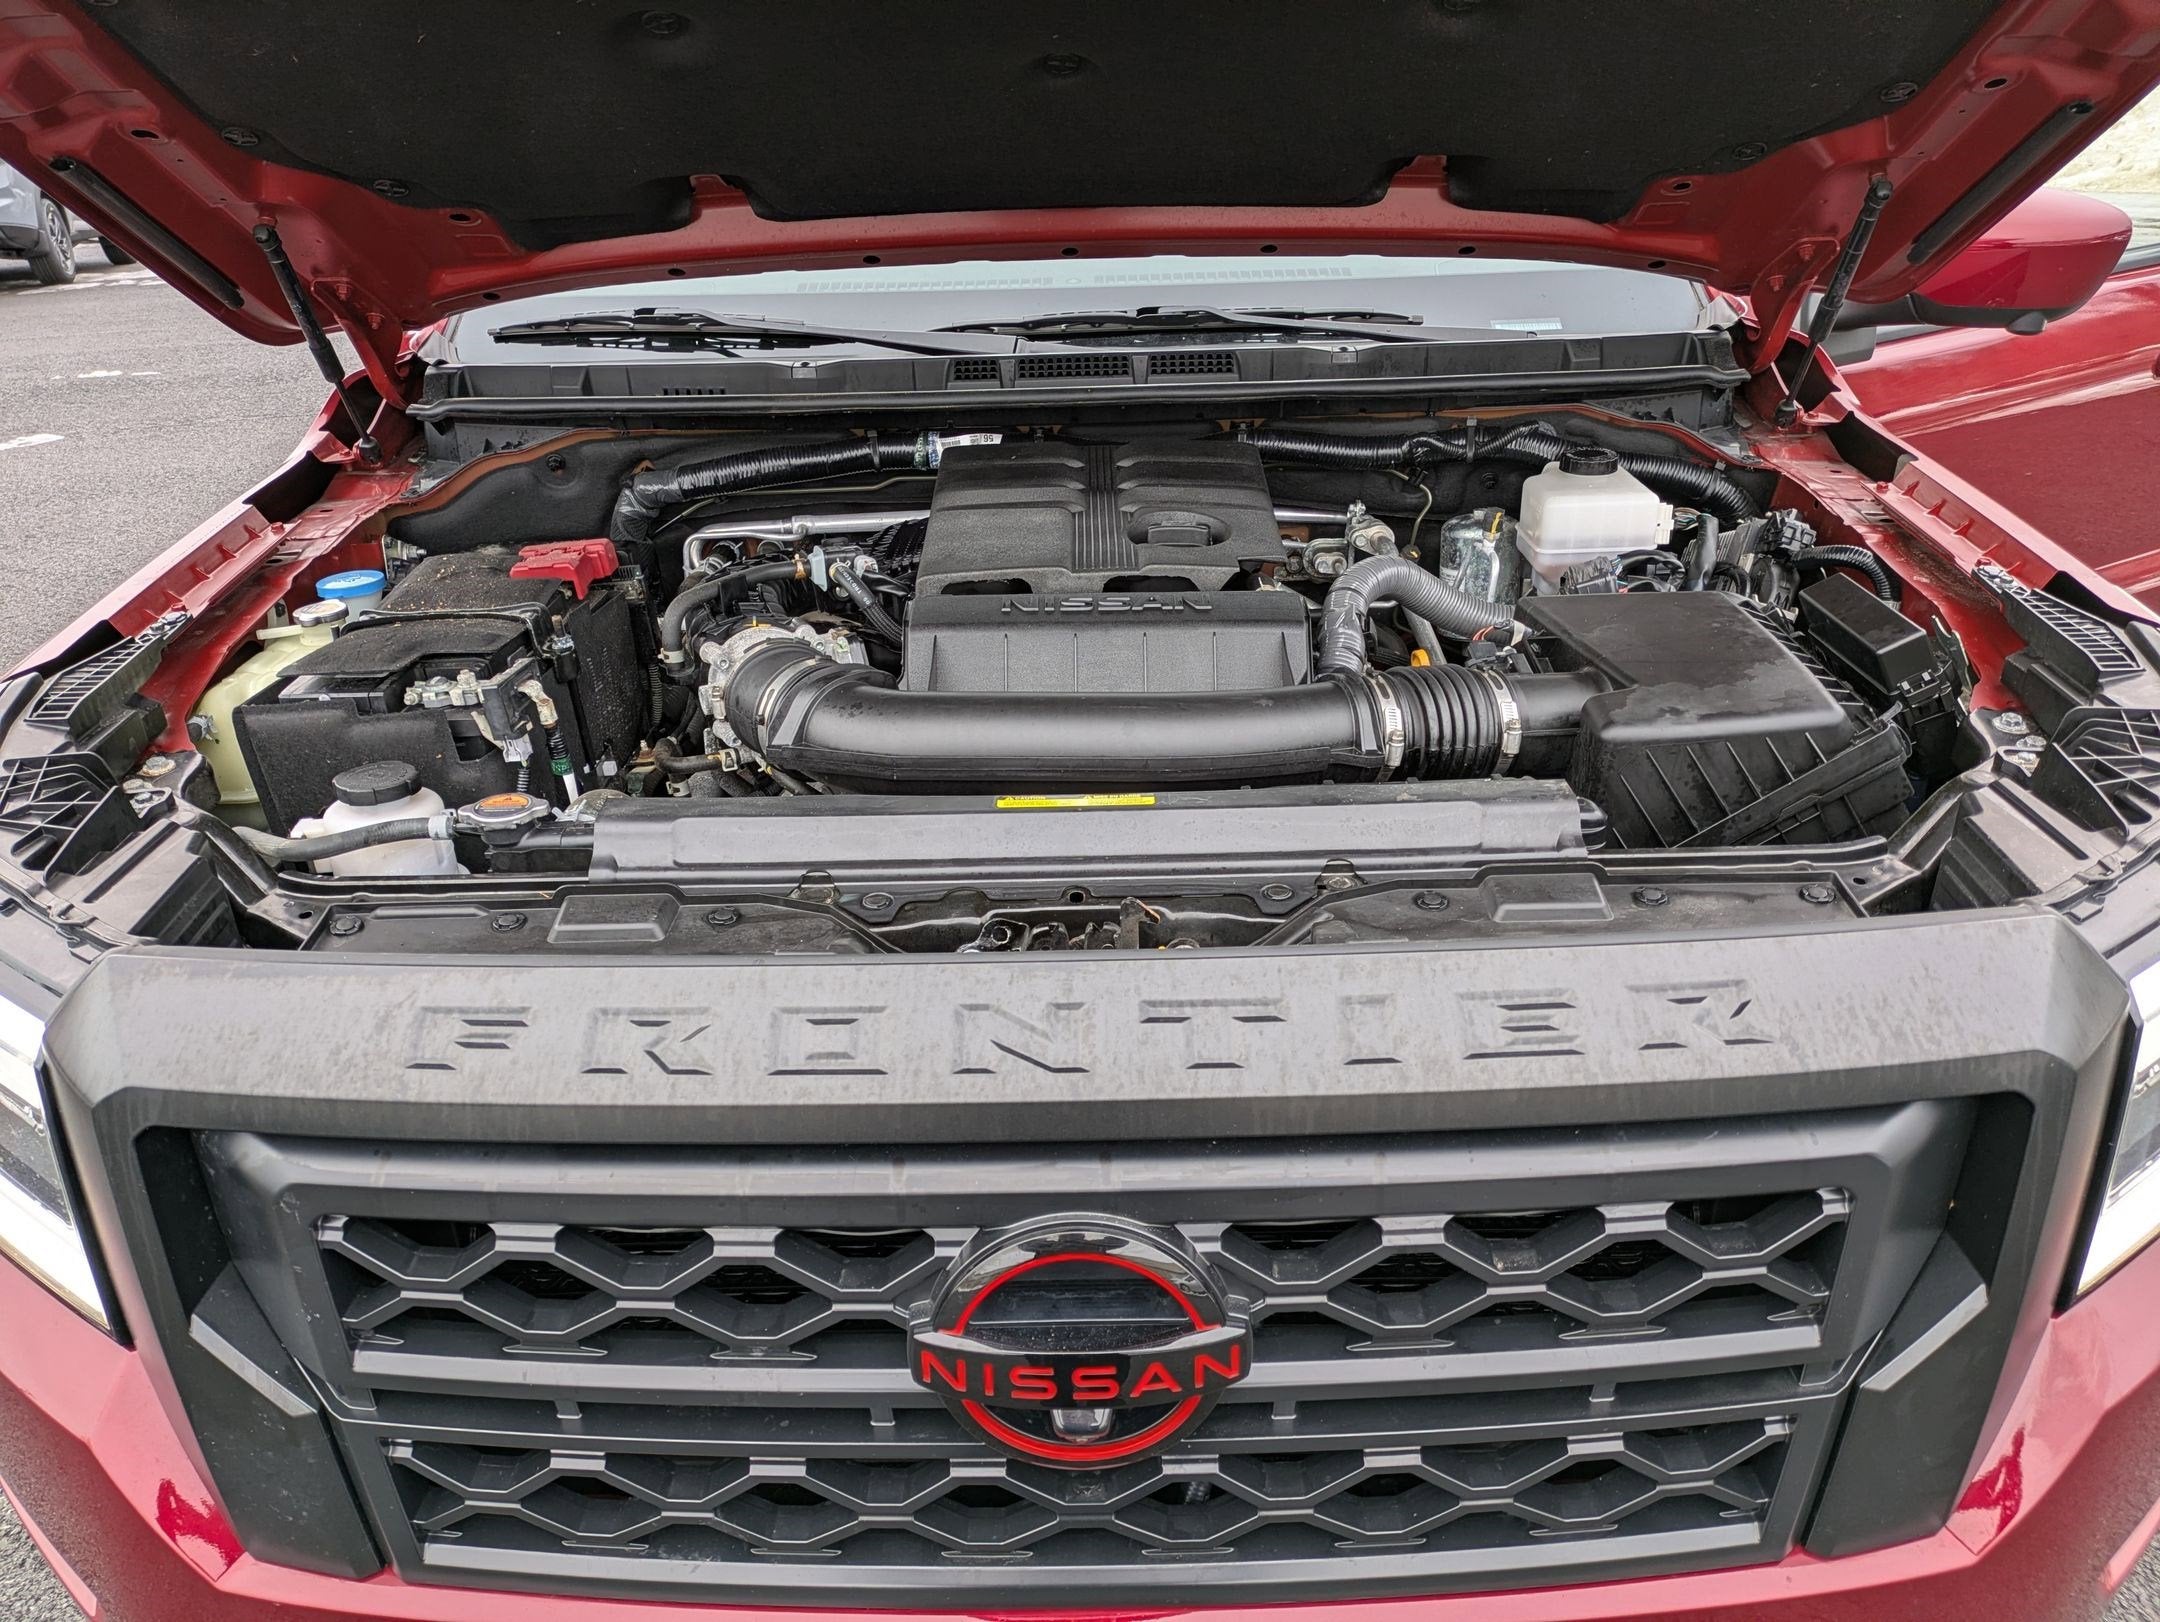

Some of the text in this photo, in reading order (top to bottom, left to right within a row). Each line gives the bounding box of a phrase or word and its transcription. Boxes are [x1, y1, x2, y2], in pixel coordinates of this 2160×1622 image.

[1001, 596, 1214, 612] NISSAN
[404, 978, 1775, 1077] FRONTIER
[920, 1344, 1241, 1401] NISSAN
